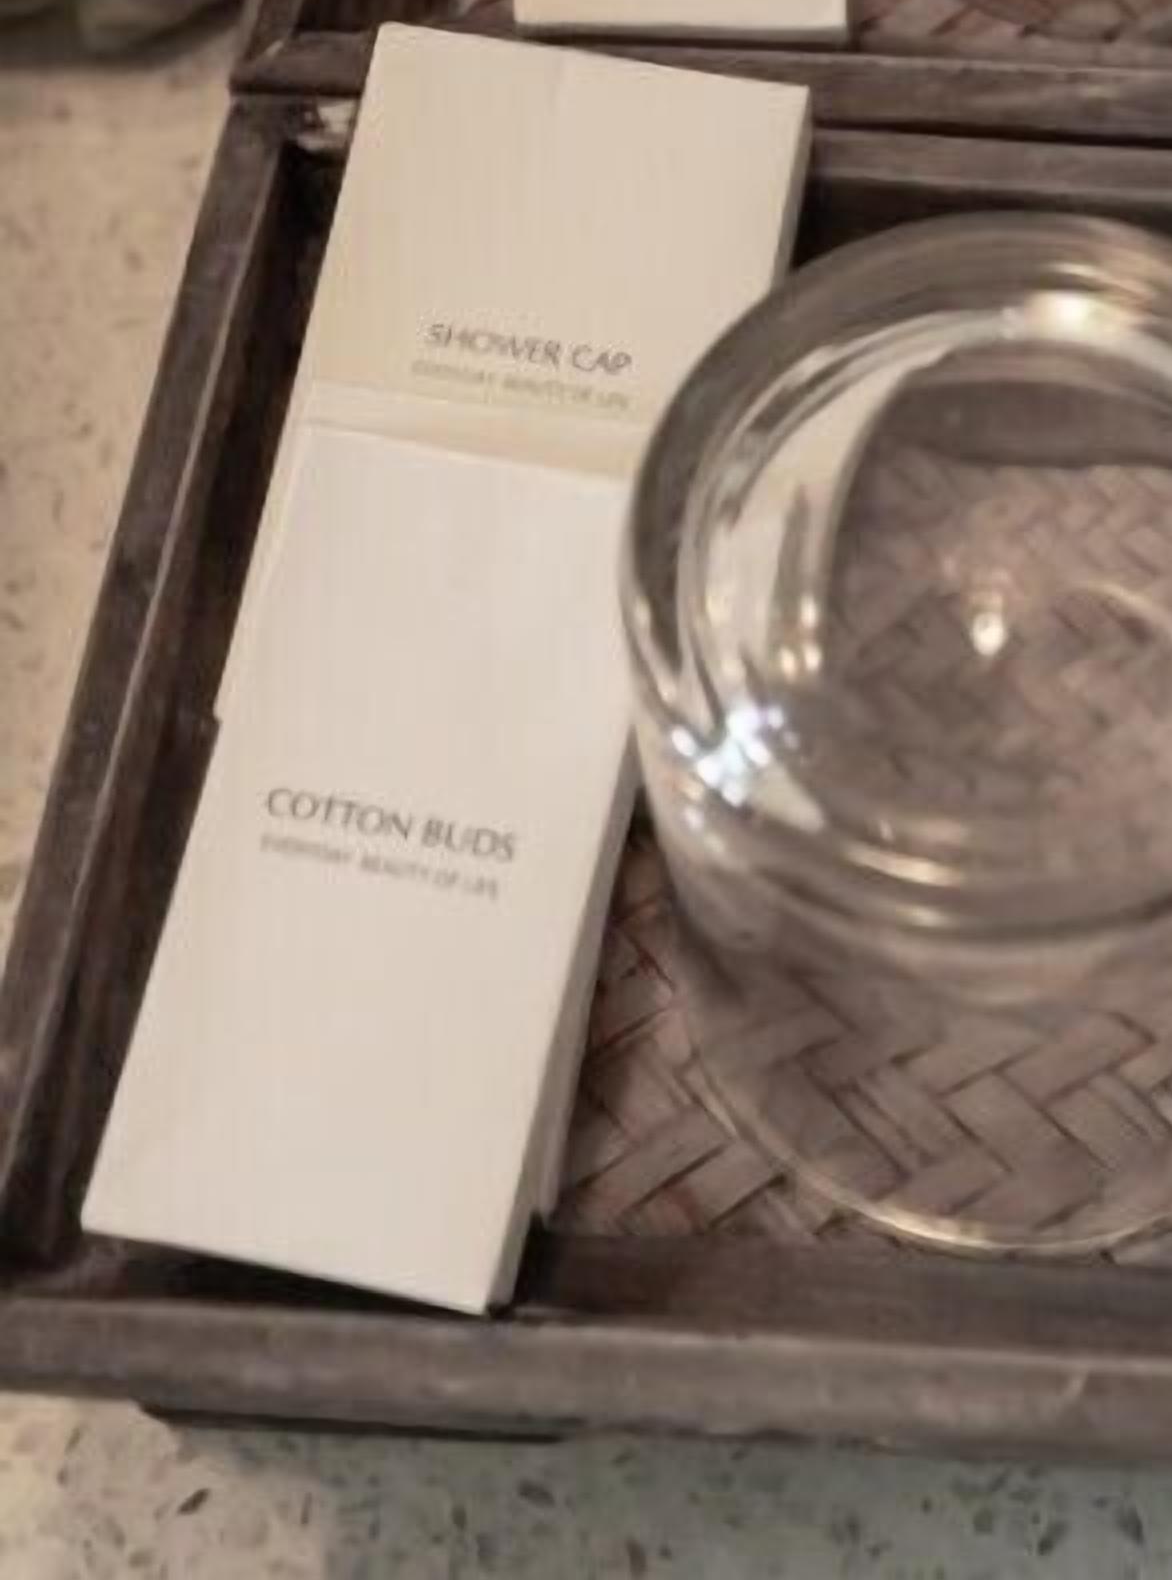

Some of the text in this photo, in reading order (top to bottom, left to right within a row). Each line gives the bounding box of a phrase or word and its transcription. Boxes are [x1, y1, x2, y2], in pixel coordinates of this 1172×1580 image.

[424, 322, 632, 375] SHOWER CAP
[266, 787, 515, 862] COTTON BUDS
